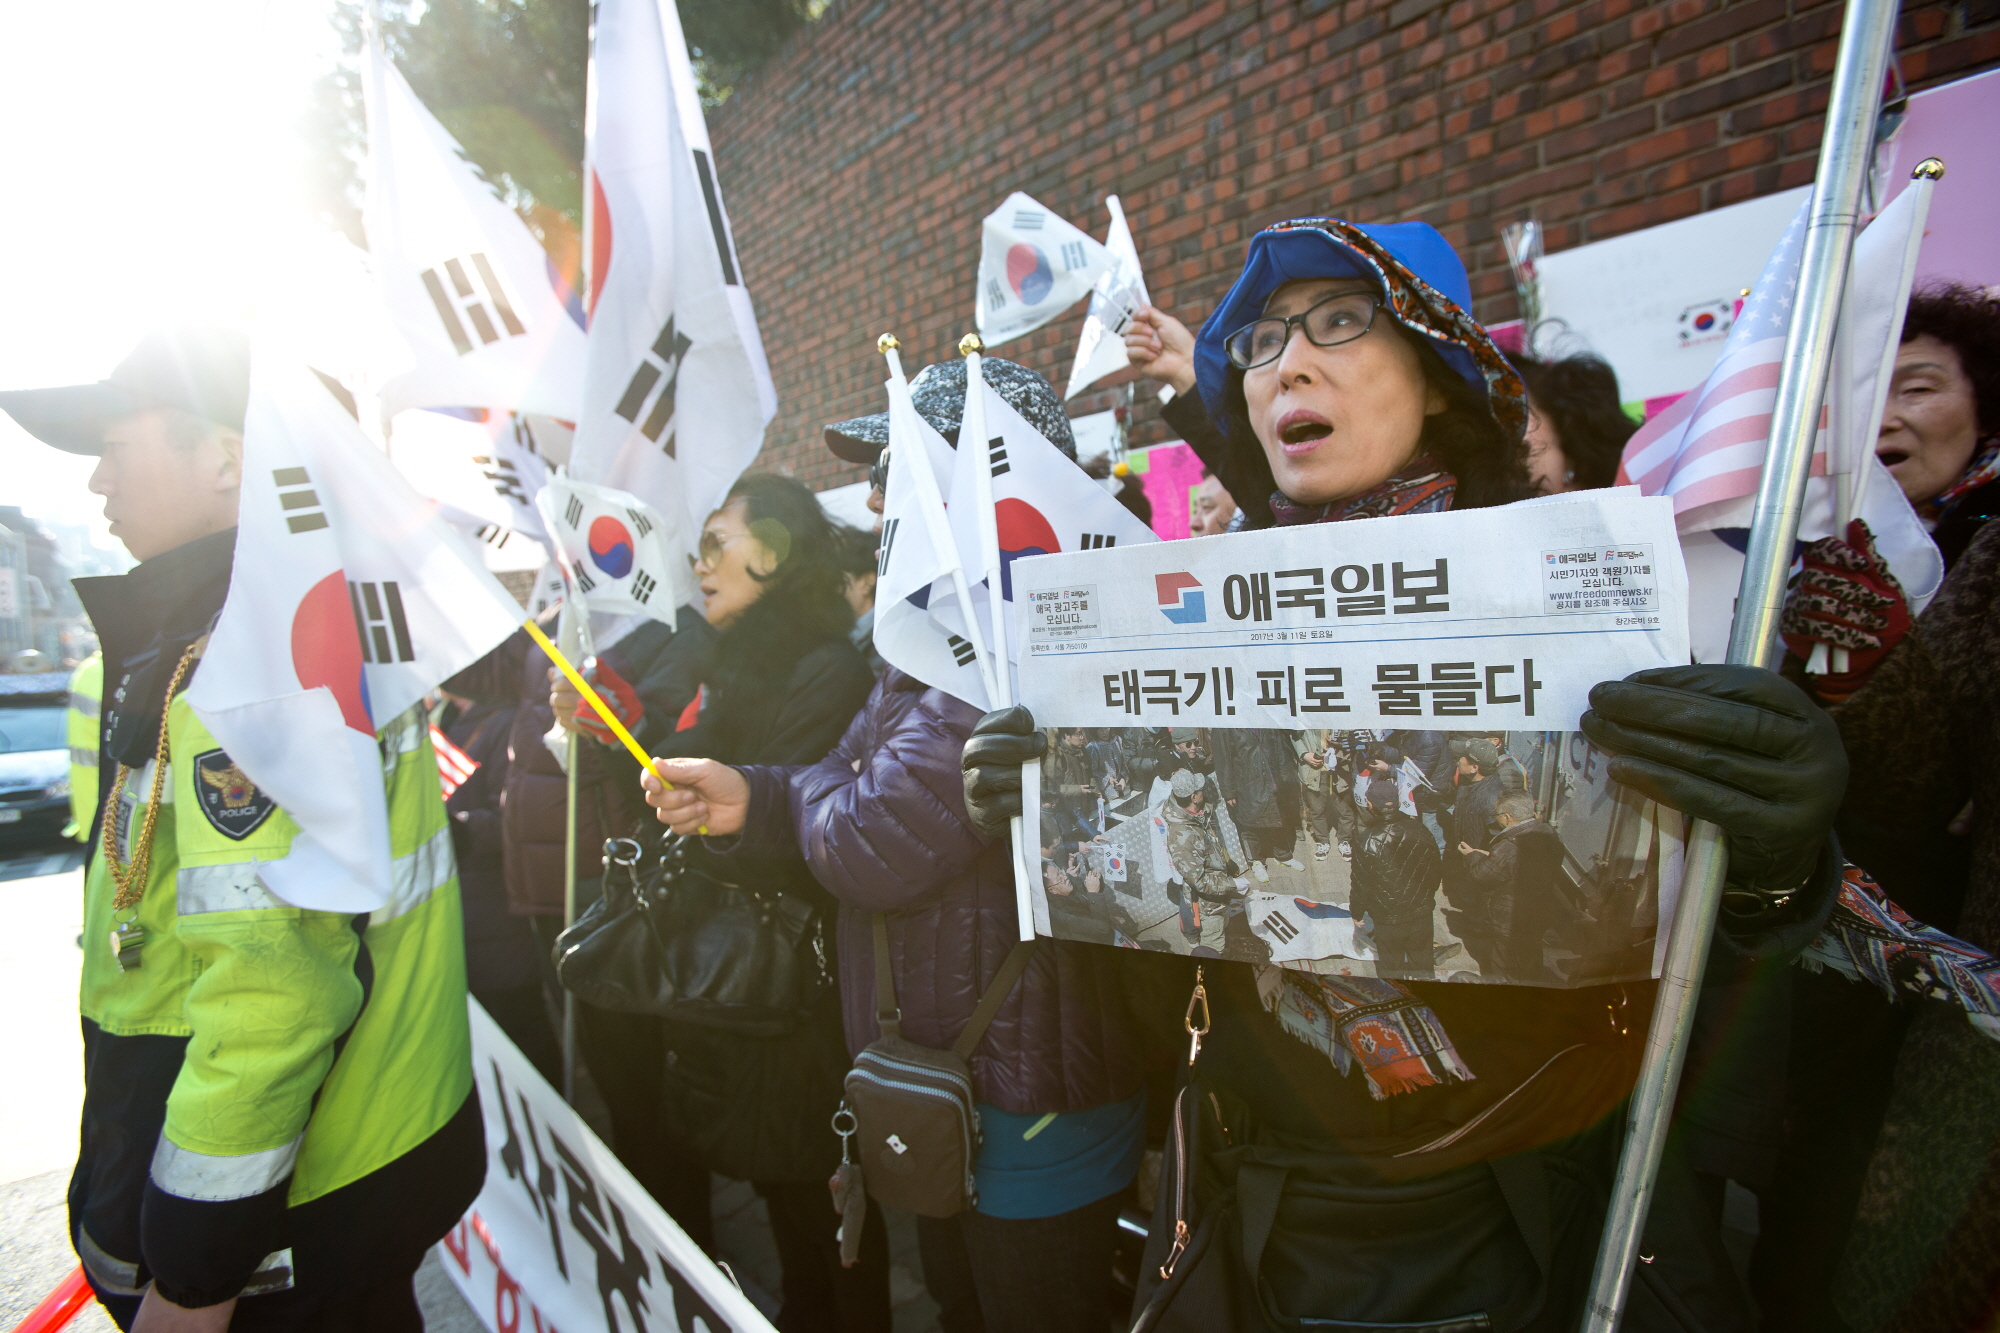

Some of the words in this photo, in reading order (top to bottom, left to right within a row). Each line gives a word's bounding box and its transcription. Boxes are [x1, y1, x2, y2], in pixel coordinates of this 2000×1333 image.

[1558, 552, 1597, 564] 애국일보
[1549, 567, 1599, 580] 시민기자와
[1602, 565, 1651, 577] 객원기자를
[1582, 577, 1625, 588] 모십니다.
[1036, 591, 1059, 601] 애국일보
[1223, 558, 1450, 622] 애국일보
[1549, 587, 1653, 601] www.freedomnews.kr
[1036, 603, 1052, 614] 애국
[1054, 600, 1089, 613] 광고주를
[1612, 597, 1648, 607] 주십시오
[1046, 613, 1083, 625] 모십니다.
[1615, 616, 1646, 626] 창간준비
[1647, 616, 1660, 625] 9호
[1250, 633, 1274, 641] 2017년
[1277, 631, 1288, 640] 3월
[1290, 631, 1307, 640] 11일
[1311, 630, 1333, 639] 토요일
[1103, 666, 1237, 716] 태극기!
[1256, 665, 1351, 717] 피로
[1371, 658, 1542, 717] 물들다
[219, 806, 258, 818] POLICE
